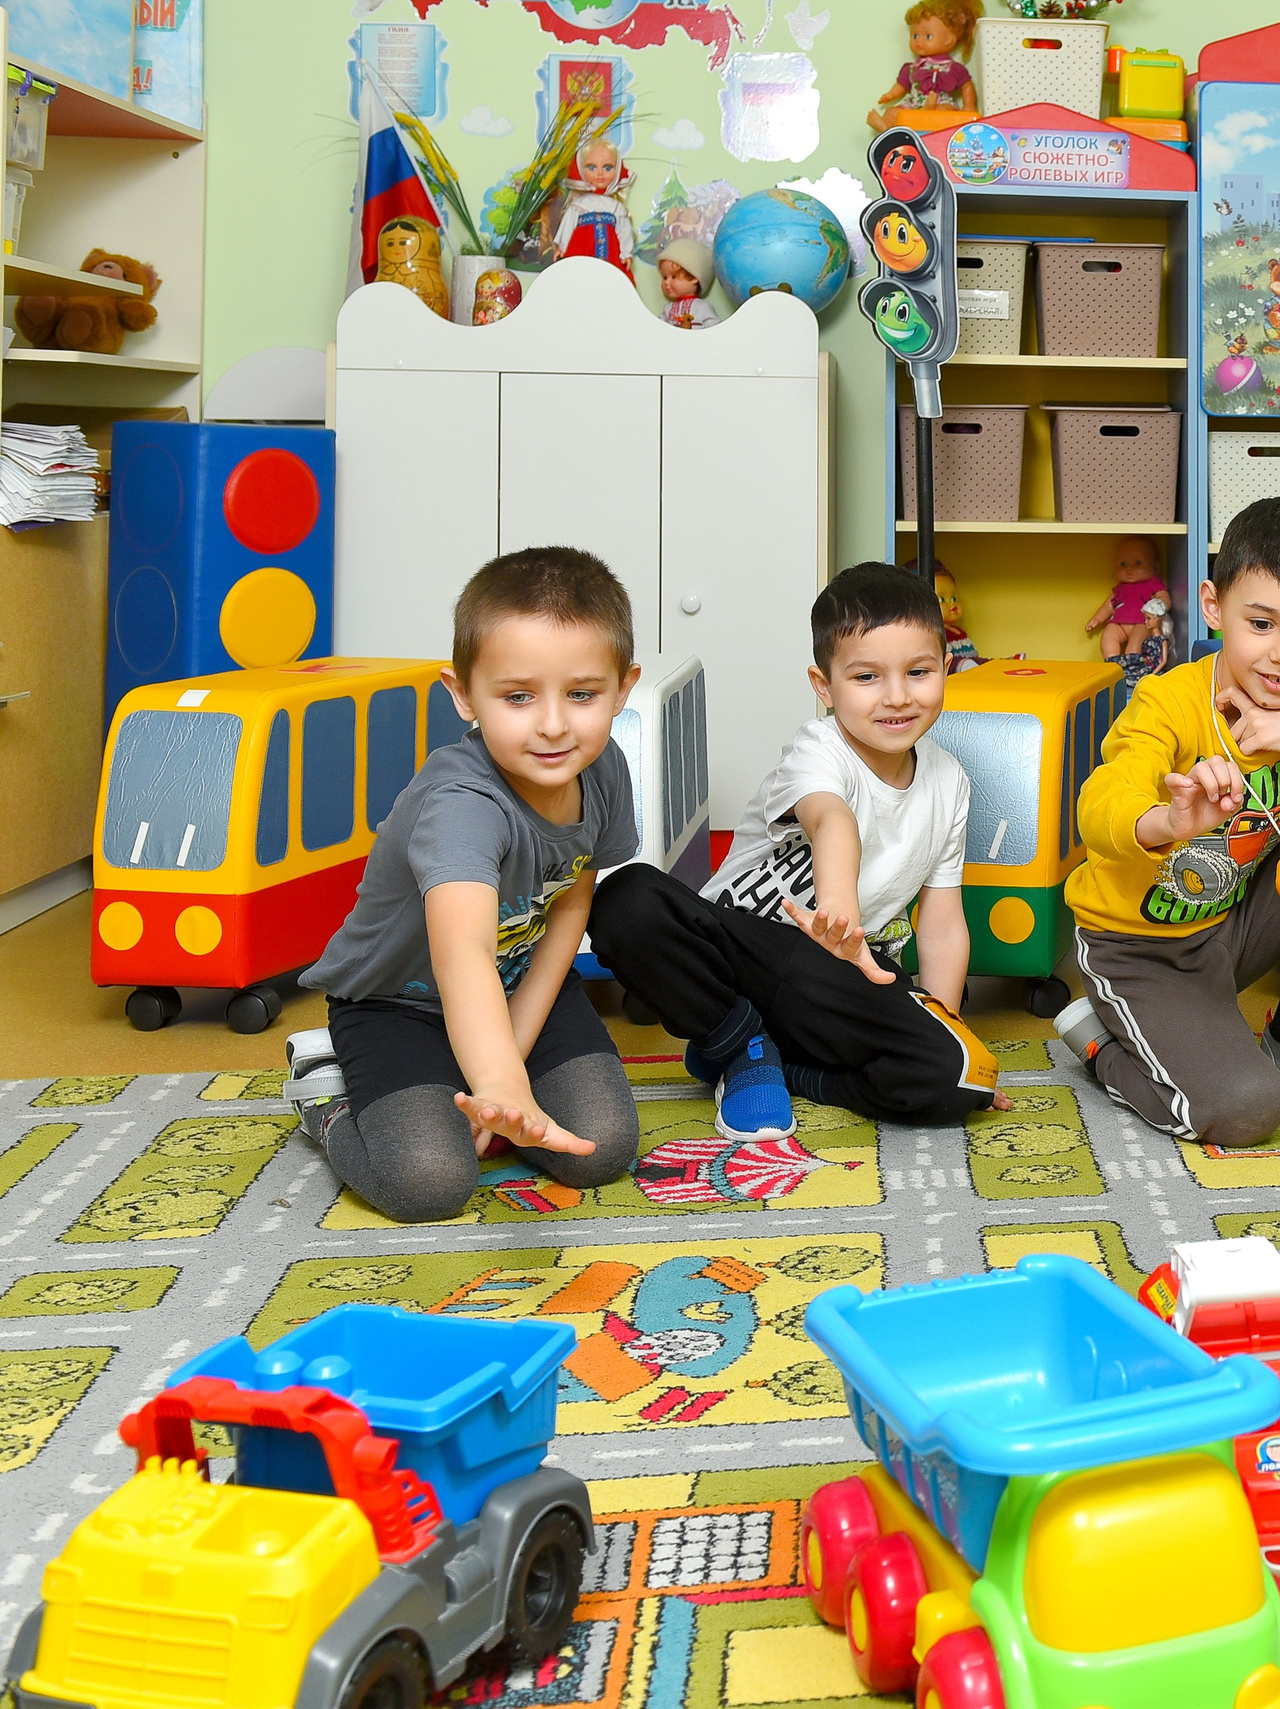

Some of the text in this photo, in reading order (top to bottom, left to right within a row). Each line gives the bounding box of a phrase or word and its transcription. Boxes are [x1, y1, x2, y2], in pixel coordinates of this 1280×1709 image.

[1034, 135, 1098, 150] УГОЛОК
[1023, 151, 1114, 167] СЮЖЕТНО-
[1009, 167, 1124, 184] РОЛЕВЫХ ИГР
